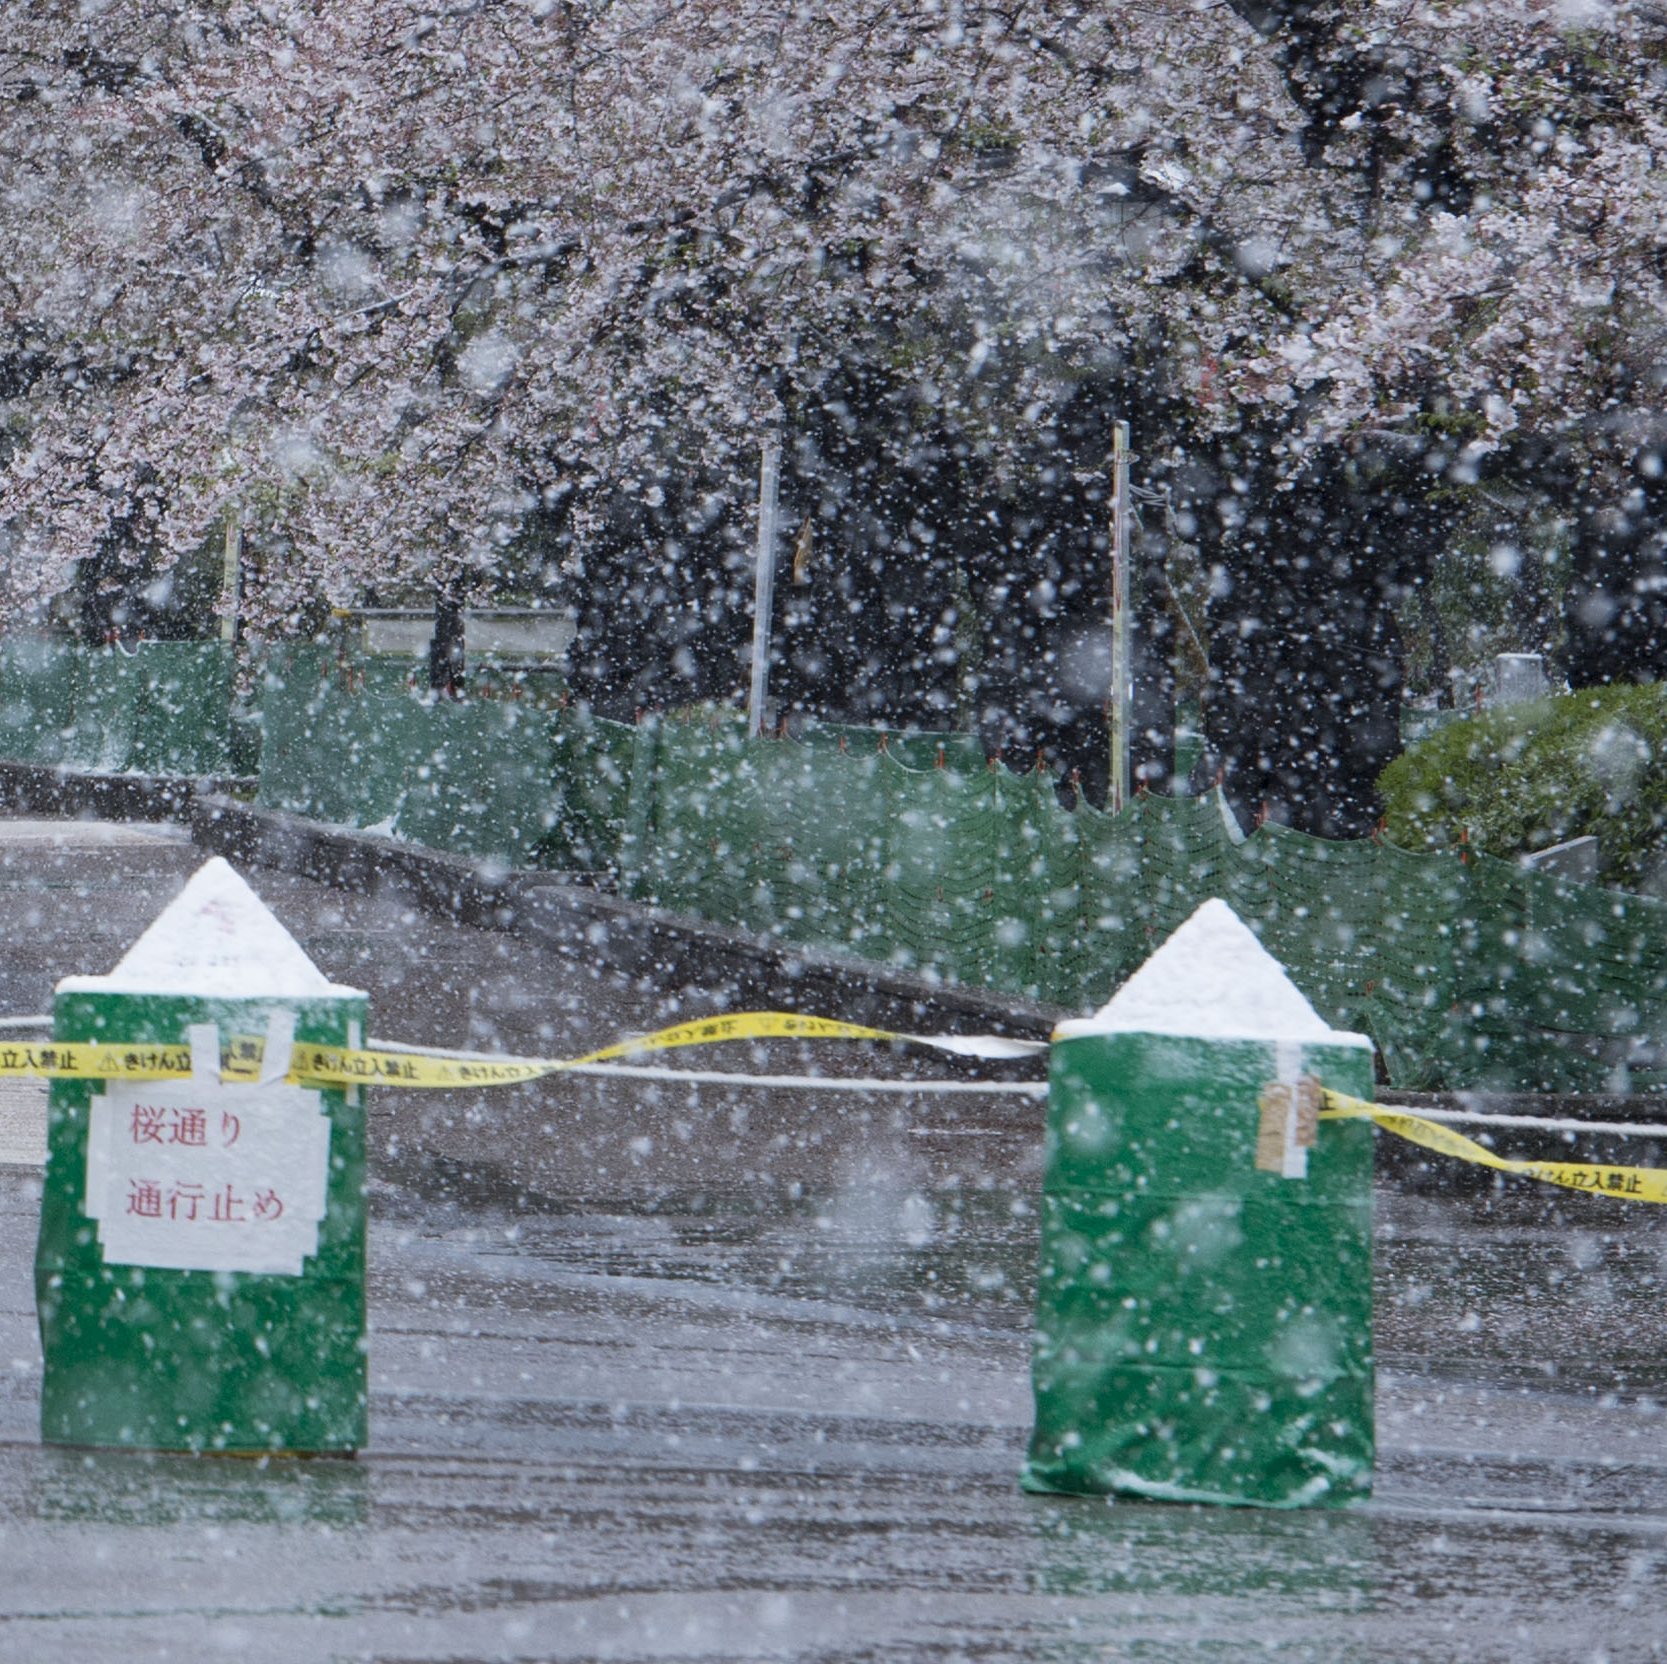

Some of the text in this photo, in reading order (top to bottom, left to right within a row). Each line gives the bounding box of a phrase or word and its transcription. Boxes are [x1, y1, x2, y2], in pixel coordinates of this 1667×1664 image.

[130, 1103, 240, 1147] 桜通り
[126, 1179, 284, 1222] 通行止め
